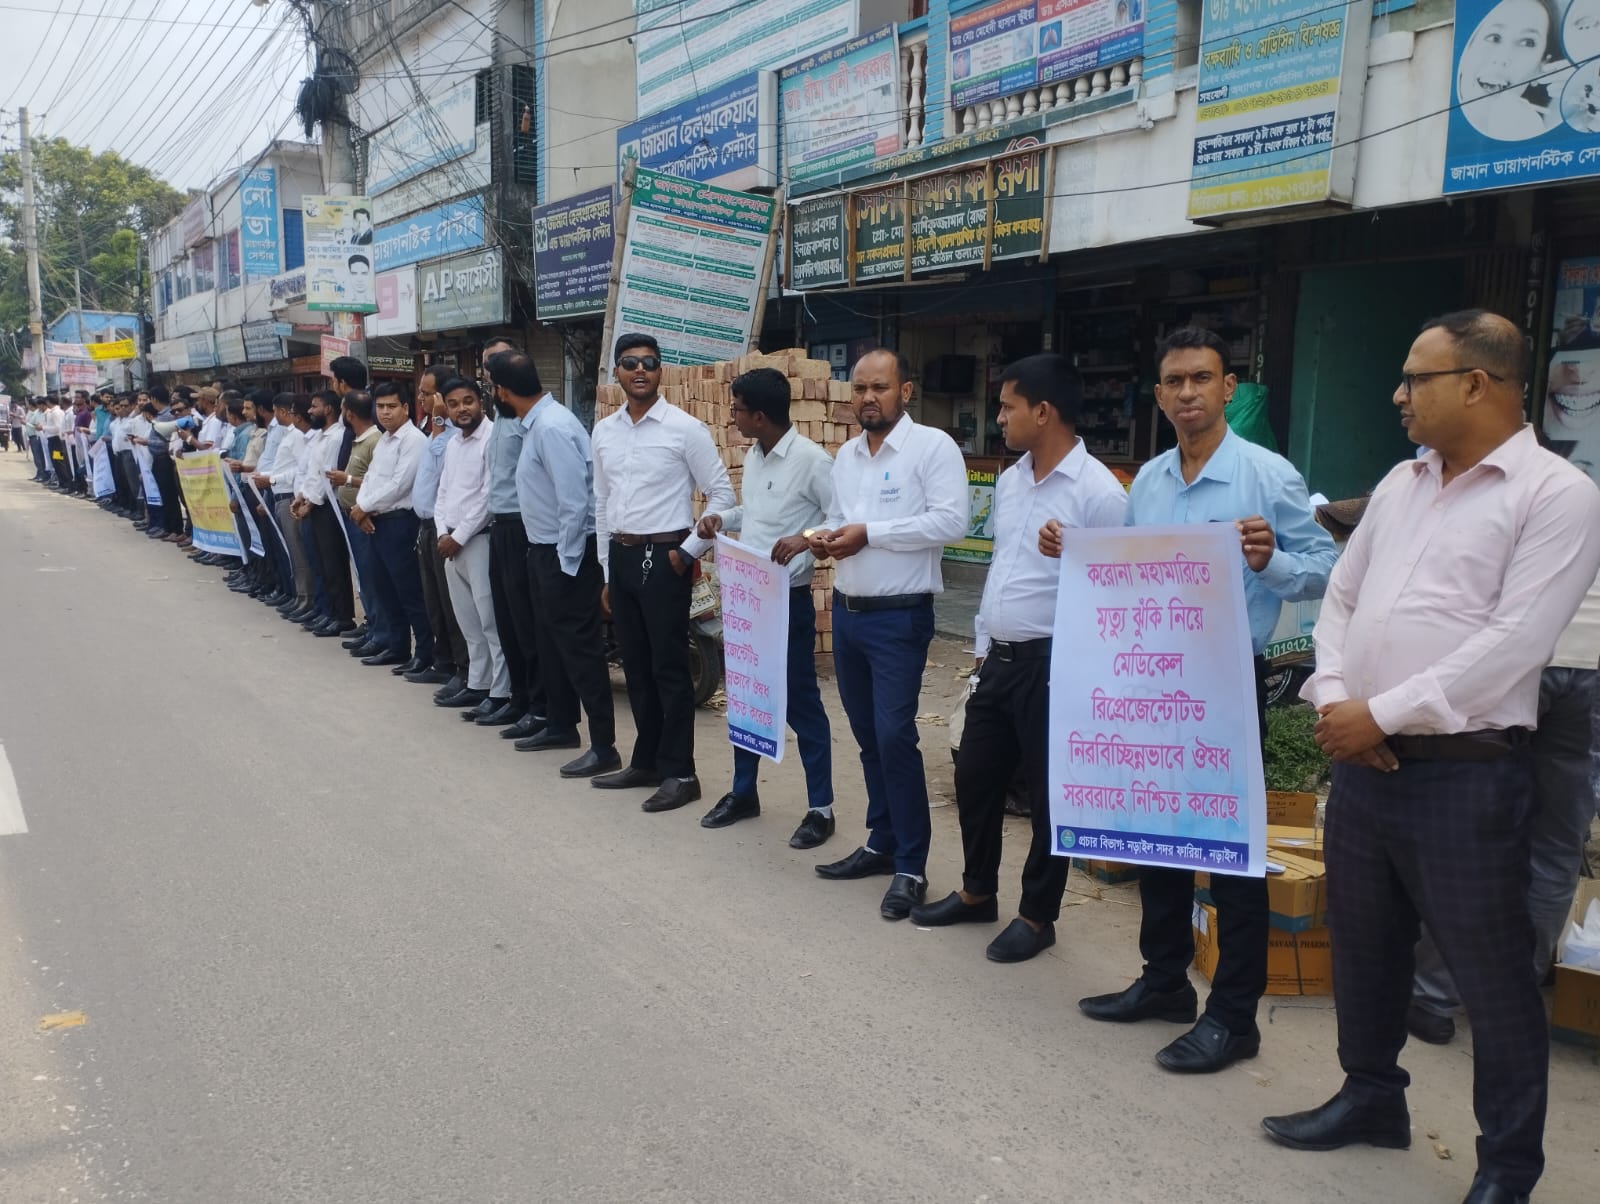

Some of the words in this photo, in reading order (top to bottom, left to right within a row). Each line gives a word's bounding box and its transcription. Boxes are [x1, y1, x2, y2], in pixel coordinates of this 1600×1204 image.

[641, 124, 678, 159] জামান
[680, 92, 758, 145] হেলথকেয়ার
[721, 131, 757, 165] সেন্টার
[1451, 162, 1489, 181] জামান
[1493, 149, 1574, 176] ডায়াগনস্টিক
[811, 215, 839, 233] প্রকার
[794, 238, 832, 257] ইনজেকশন
[832, 237, 839, 251] ও
[424, 268, 453, 304] AP
[1086, 562, 1133, 587] করোনা
[1135, 552, 1211, 585] মহামারিতে
[1096, 607, 1127, 642] মৃত্যু
[1132, 596, 1163, 640] ঝুঁকি
[1168, 596, 1204, 633] নিয়ে
[1113, 643, 1185, 678] মেডিকেল
[1091, 687, 1207, 724] রিপ্রেজেন্টেটিভ
[1067, 731, 1185, 773] নিরবিচ্ছিন্নভাবে
[1192, 736, 1231, 772] ঔষধ
[1062, 783, 1127, 814] সরবরাহে
[1131, 780, 1182, 815] নিশ্চিত
[1186, 791, 1240, 825] করেছে
[1078, 835, 1098, 849] প্রচার
[1127, 839, 1154, 856] নড়াইল
[1156, 843, 1174, 856] সদর
